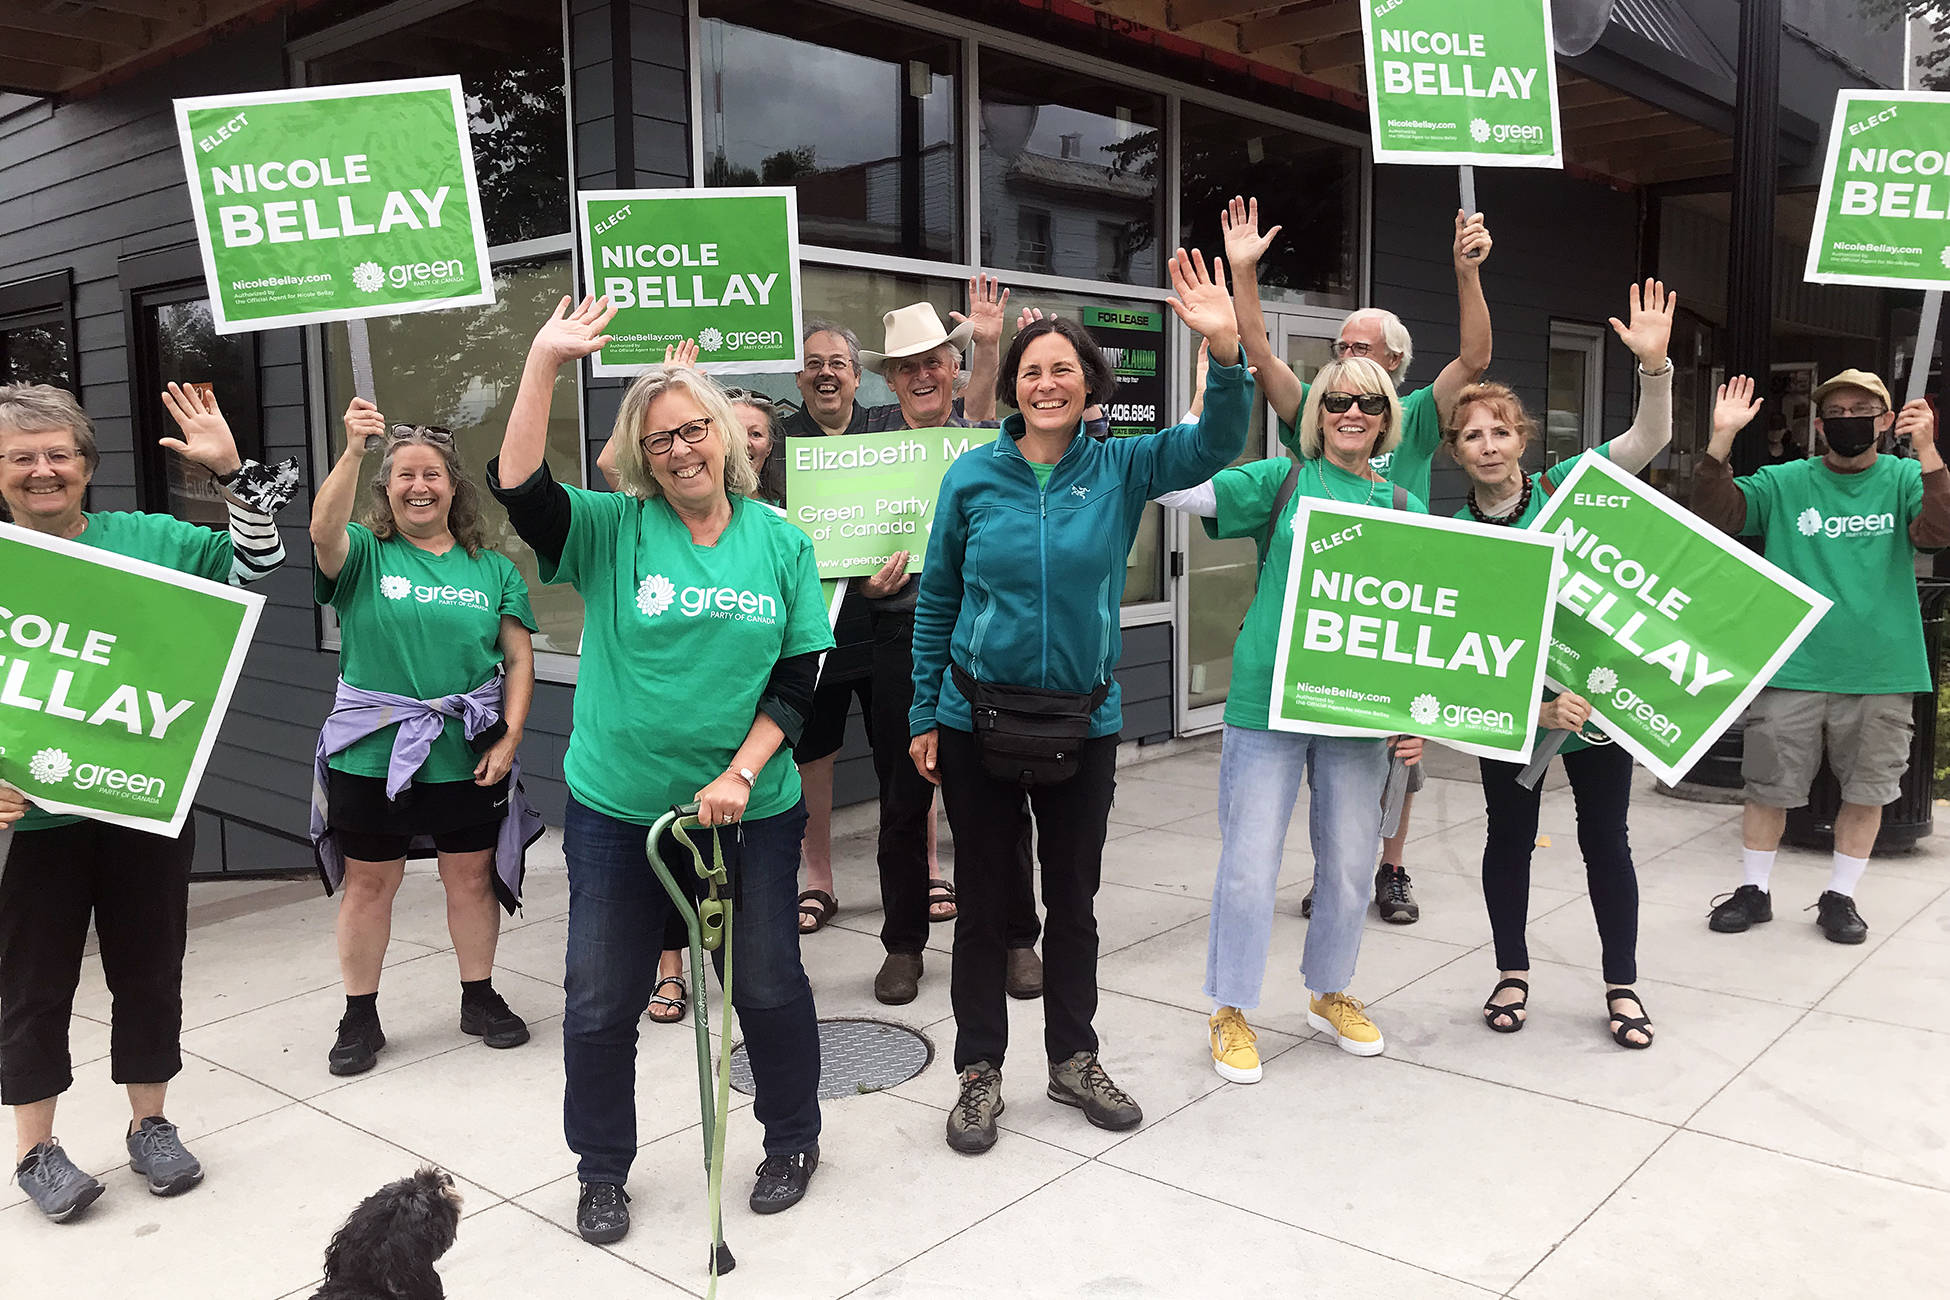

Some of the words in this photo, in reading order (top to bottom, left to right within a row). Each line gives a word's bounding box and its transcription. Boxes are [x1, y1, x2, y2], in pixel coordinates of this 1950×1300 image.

[1381, 29, 1486, 56] NICOLE
[1383, 60, 1538, 100] BELLAY
[199, 112, 249, 153] ELECT
[1388, 120, 1456, 130] NicoleBellay.com
[1492, 124, 1543, 142] green
[1848, 106, 1898, 136] ELECT
[212, 154, 371, 195] NICOLE
[1840, 180, 1950, 220] BEL
[219, 186, 450, 248] BELLAY
[594, 205, 632, 235] ELECT
[601, 244, 719, 268] NICOLE
[1833, 242, 1922, 255] NicoleBellay.com
[232, 273, 332, 290] NicoleBellay.com
[389, 259, 464, 289] green
[441, 276, 464, 284] CANADA
[234, 290, 266, 298] Authorized
[604, 272, 779, 309] BELLAY
[1098, 312, 1118, 322] FOR
[1119, 313, 1149, 326] LEASE
[612, 334, 683, 342] NicoleBellay.com
[726, 331, 783, 350] green
[796, 440, 926, 471] Elizabeth
[798, 504, 864, 522] Green
[876, 497, 929, 517] Party
[1574, 493, 1631, 508] ELECT
[813, 525, 831, 540] of
[840, 519, 916, 537] Canada
[1824, 512, 1894, 538] green
[1310, 524, 1363, 555] ELECT
[1554, 517, 1692, 621] NICOLE
[414, 585, 488, 607] green
[680, 586, 776, 616] green
[1310, 568, 1459, 618] NICOLE
[710, 611, 733, 620] PARTY
[746, 615, 775, 624] CANADA
[1556, 560, 1734, 697] ELLAY
[1303, 608, 1526, 678] BELLAY
[1297, 682, 1391, 703] NicoleBellay.com
[1443, 704, 1513, 730] green
[1611, 688, 1681, 743] green
[73, 763, 166, 798] green
[99, 788, 120, 796] PARTY
[132, 794, 160, 804] CANADA
